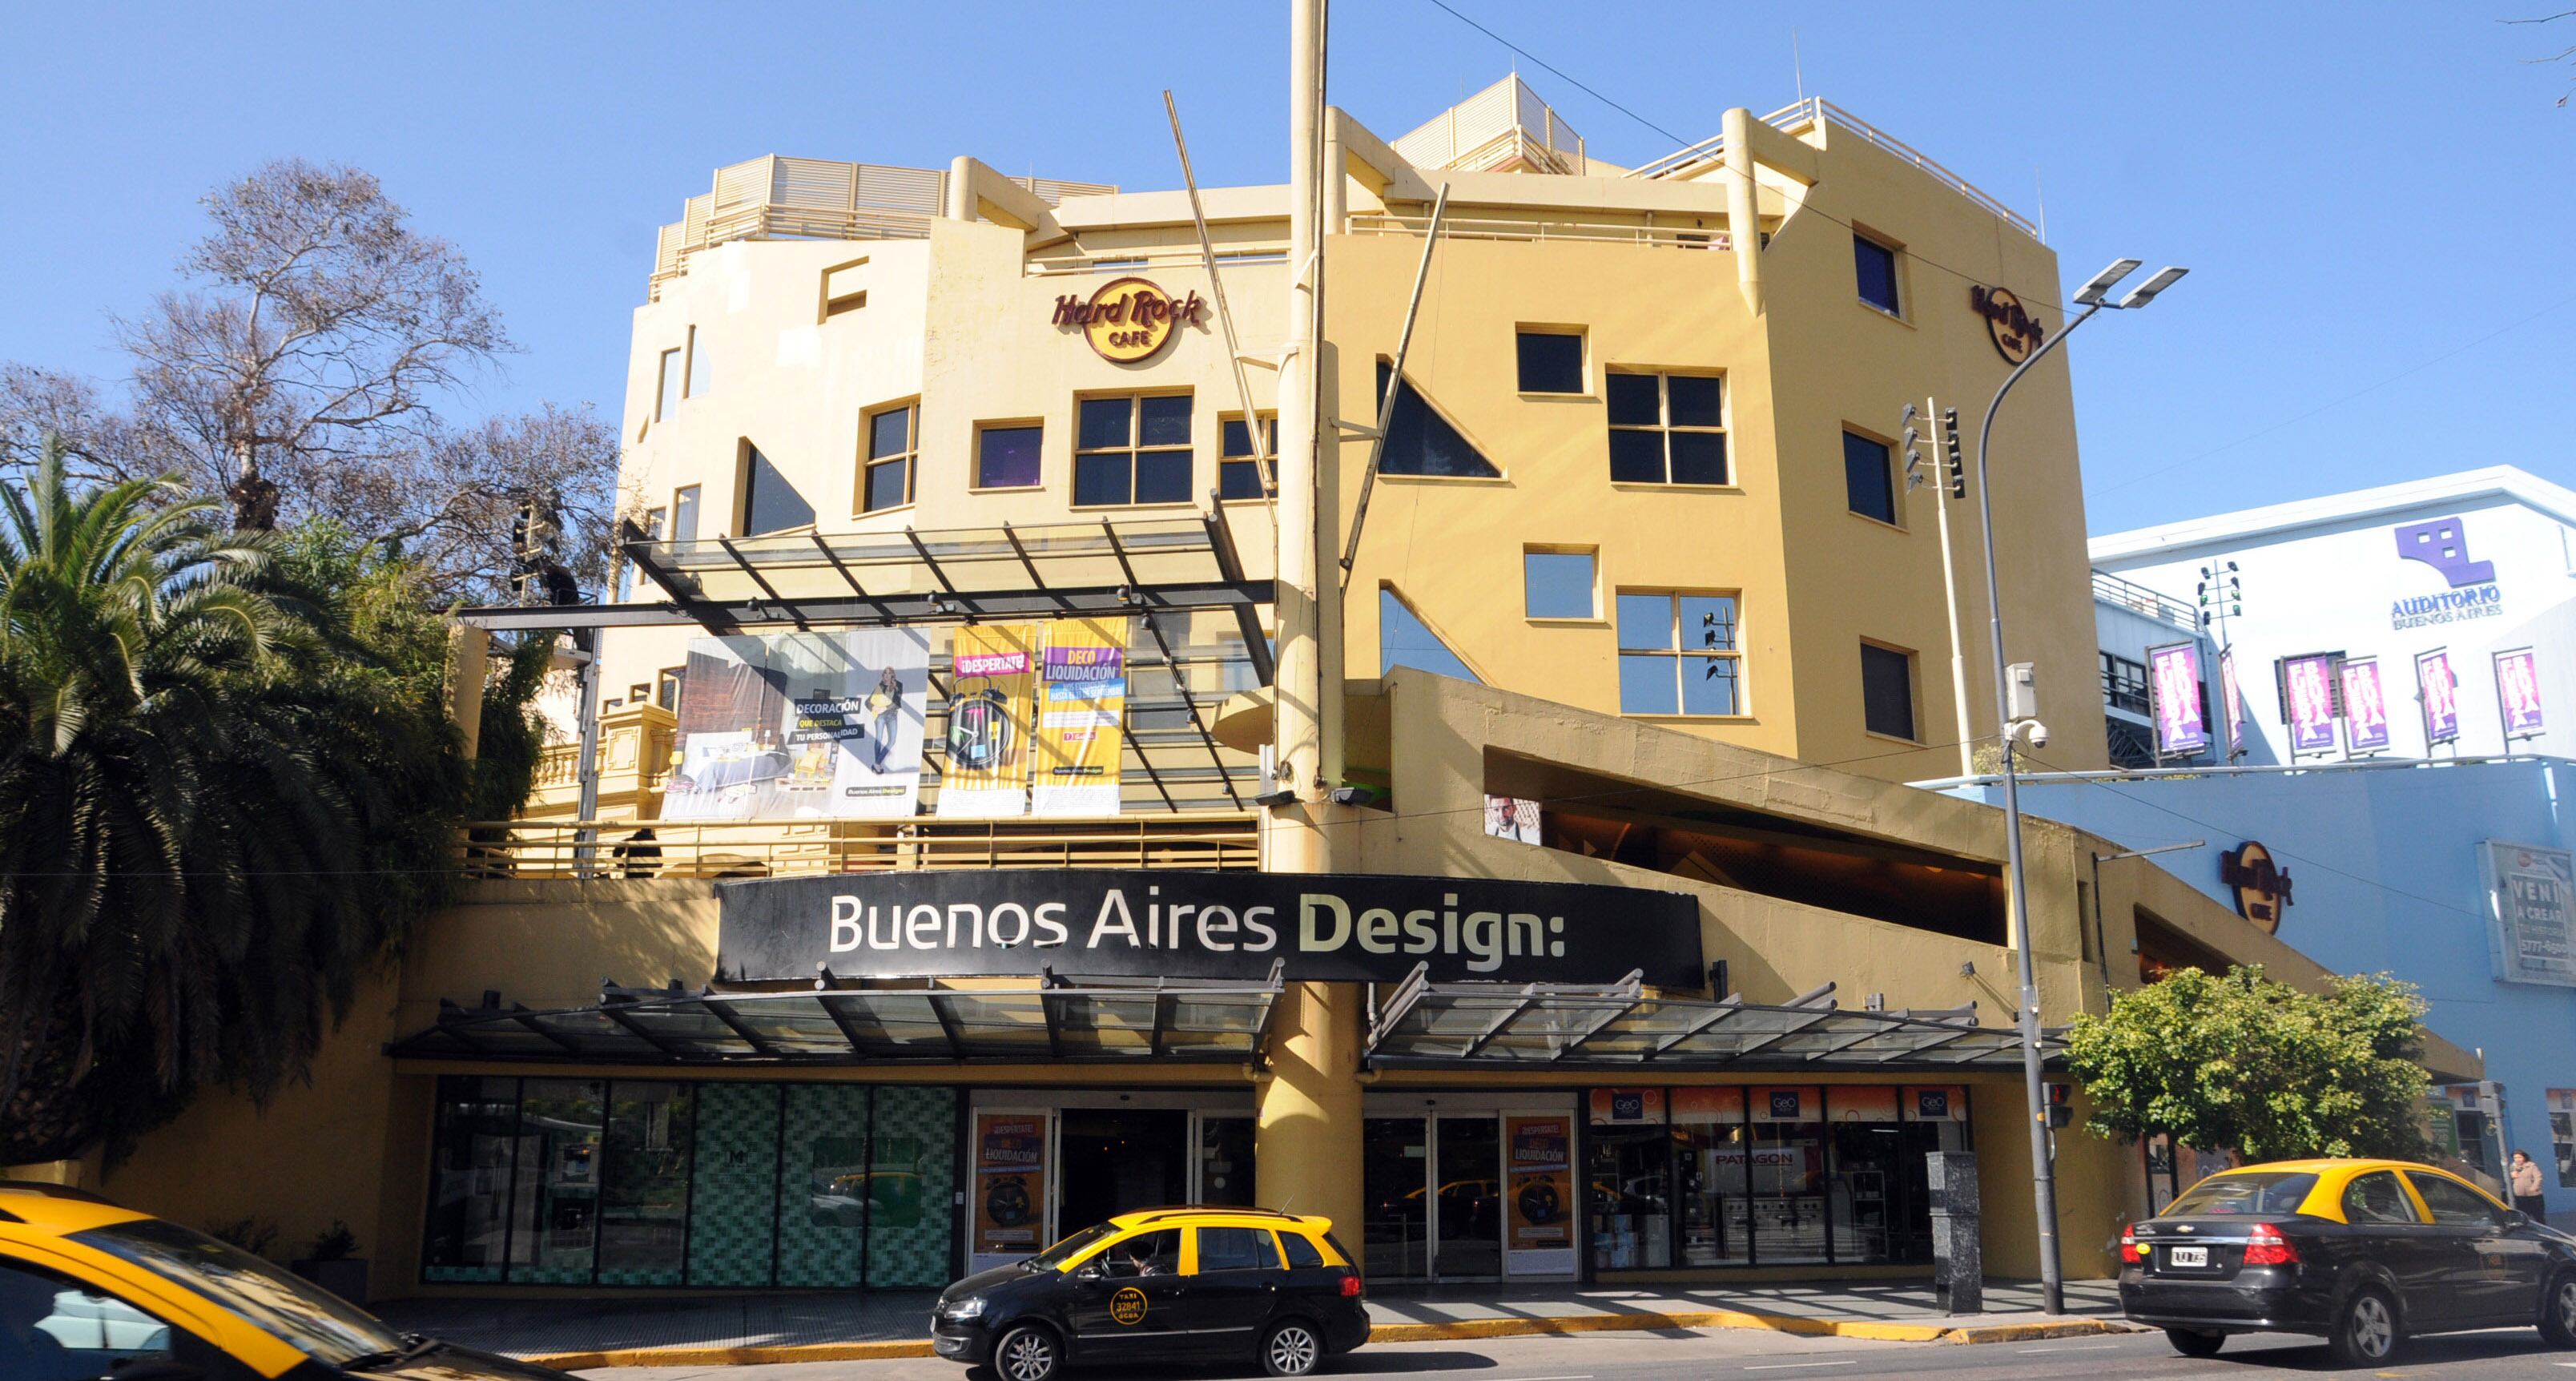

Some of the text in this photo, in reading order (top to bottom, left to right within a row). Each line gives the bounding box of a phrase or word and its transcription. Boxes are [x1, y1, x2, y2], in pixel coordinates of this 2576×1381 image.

[1052, 290, 1201, 328] Hard Rock
[1109, 331, 1150, 346] CAFE
[2392, 585, 2501, 618] AUDITORIO
[2393, 604, 2502, 630] BUENOS AIRES
[961, 654, 1024, 673] ¡DESPERTATE!
[1068, 650, 1096, 665] DECO
[1046, 662, 1117, 680] LIQUIDACIÓN
[796, 699, 859, 714] DECORACIÓN
[799, 719, 843, 728] QUE DESTACA
[796, 728, 858, 742] TU PERSONALIDAD
[2526, 907, 2562, 922] CREAR
[830, 886, 1566, 971] Buenos Aires Design:
[986, 1148, 1037, 1163] LIQUIDACIÓN
[1515, 1149, 1564, 1162] LIQUIDACIÓN
